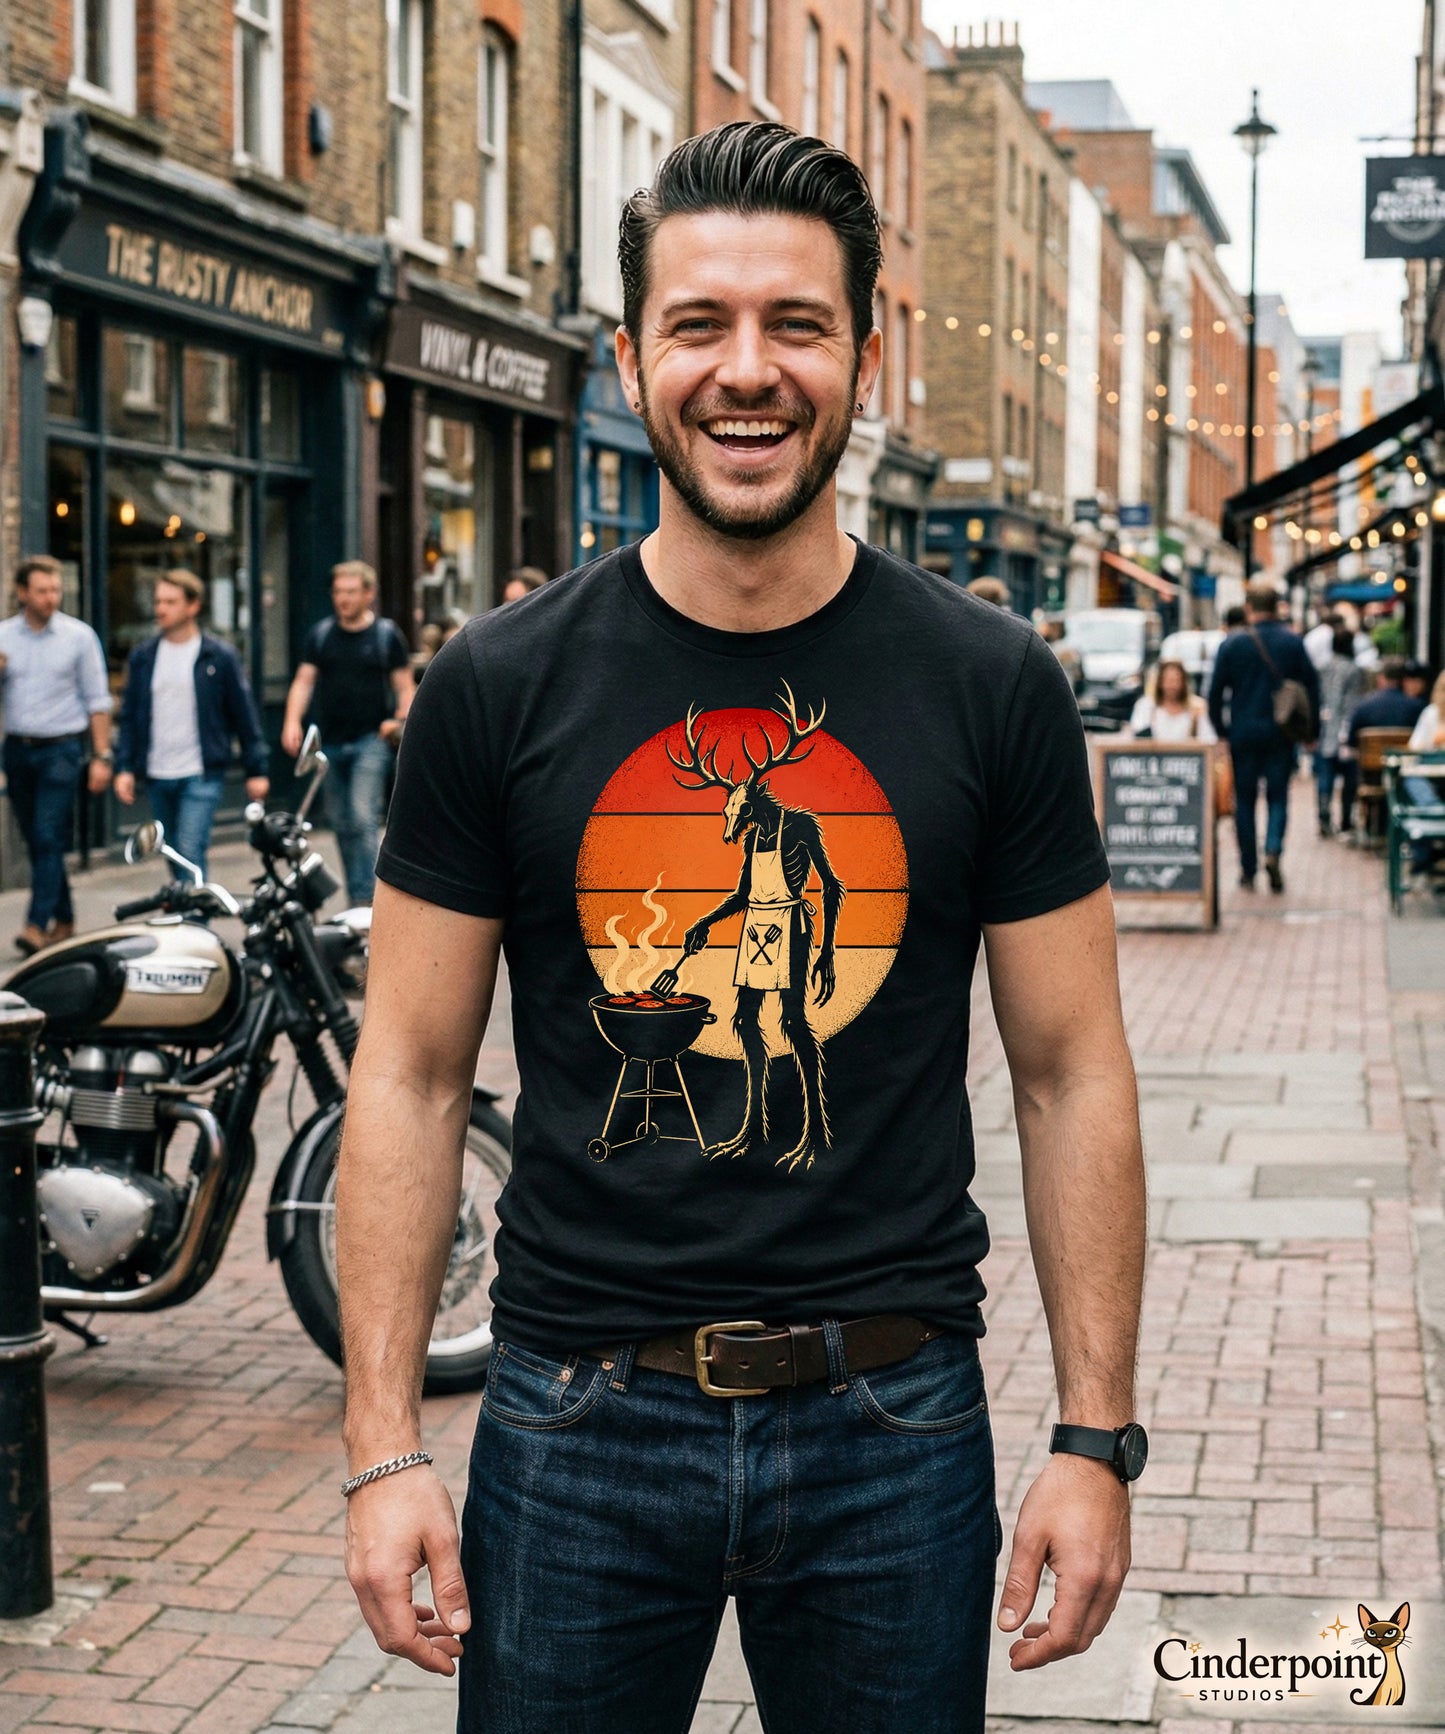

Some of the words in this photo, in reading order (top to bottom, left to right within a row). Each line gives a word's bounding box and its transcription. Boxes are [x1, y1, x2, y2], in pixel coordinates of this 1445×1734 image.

[106, 223, 154, 287] THE
[156, 239, 231, 308] RUSTY
[229, 265, 314, 331] ANCHOR
[420, 320, 471, 379] VINYL
[472, 337, 488, 383] &
[487, 344, 549, 401] COFFEE
